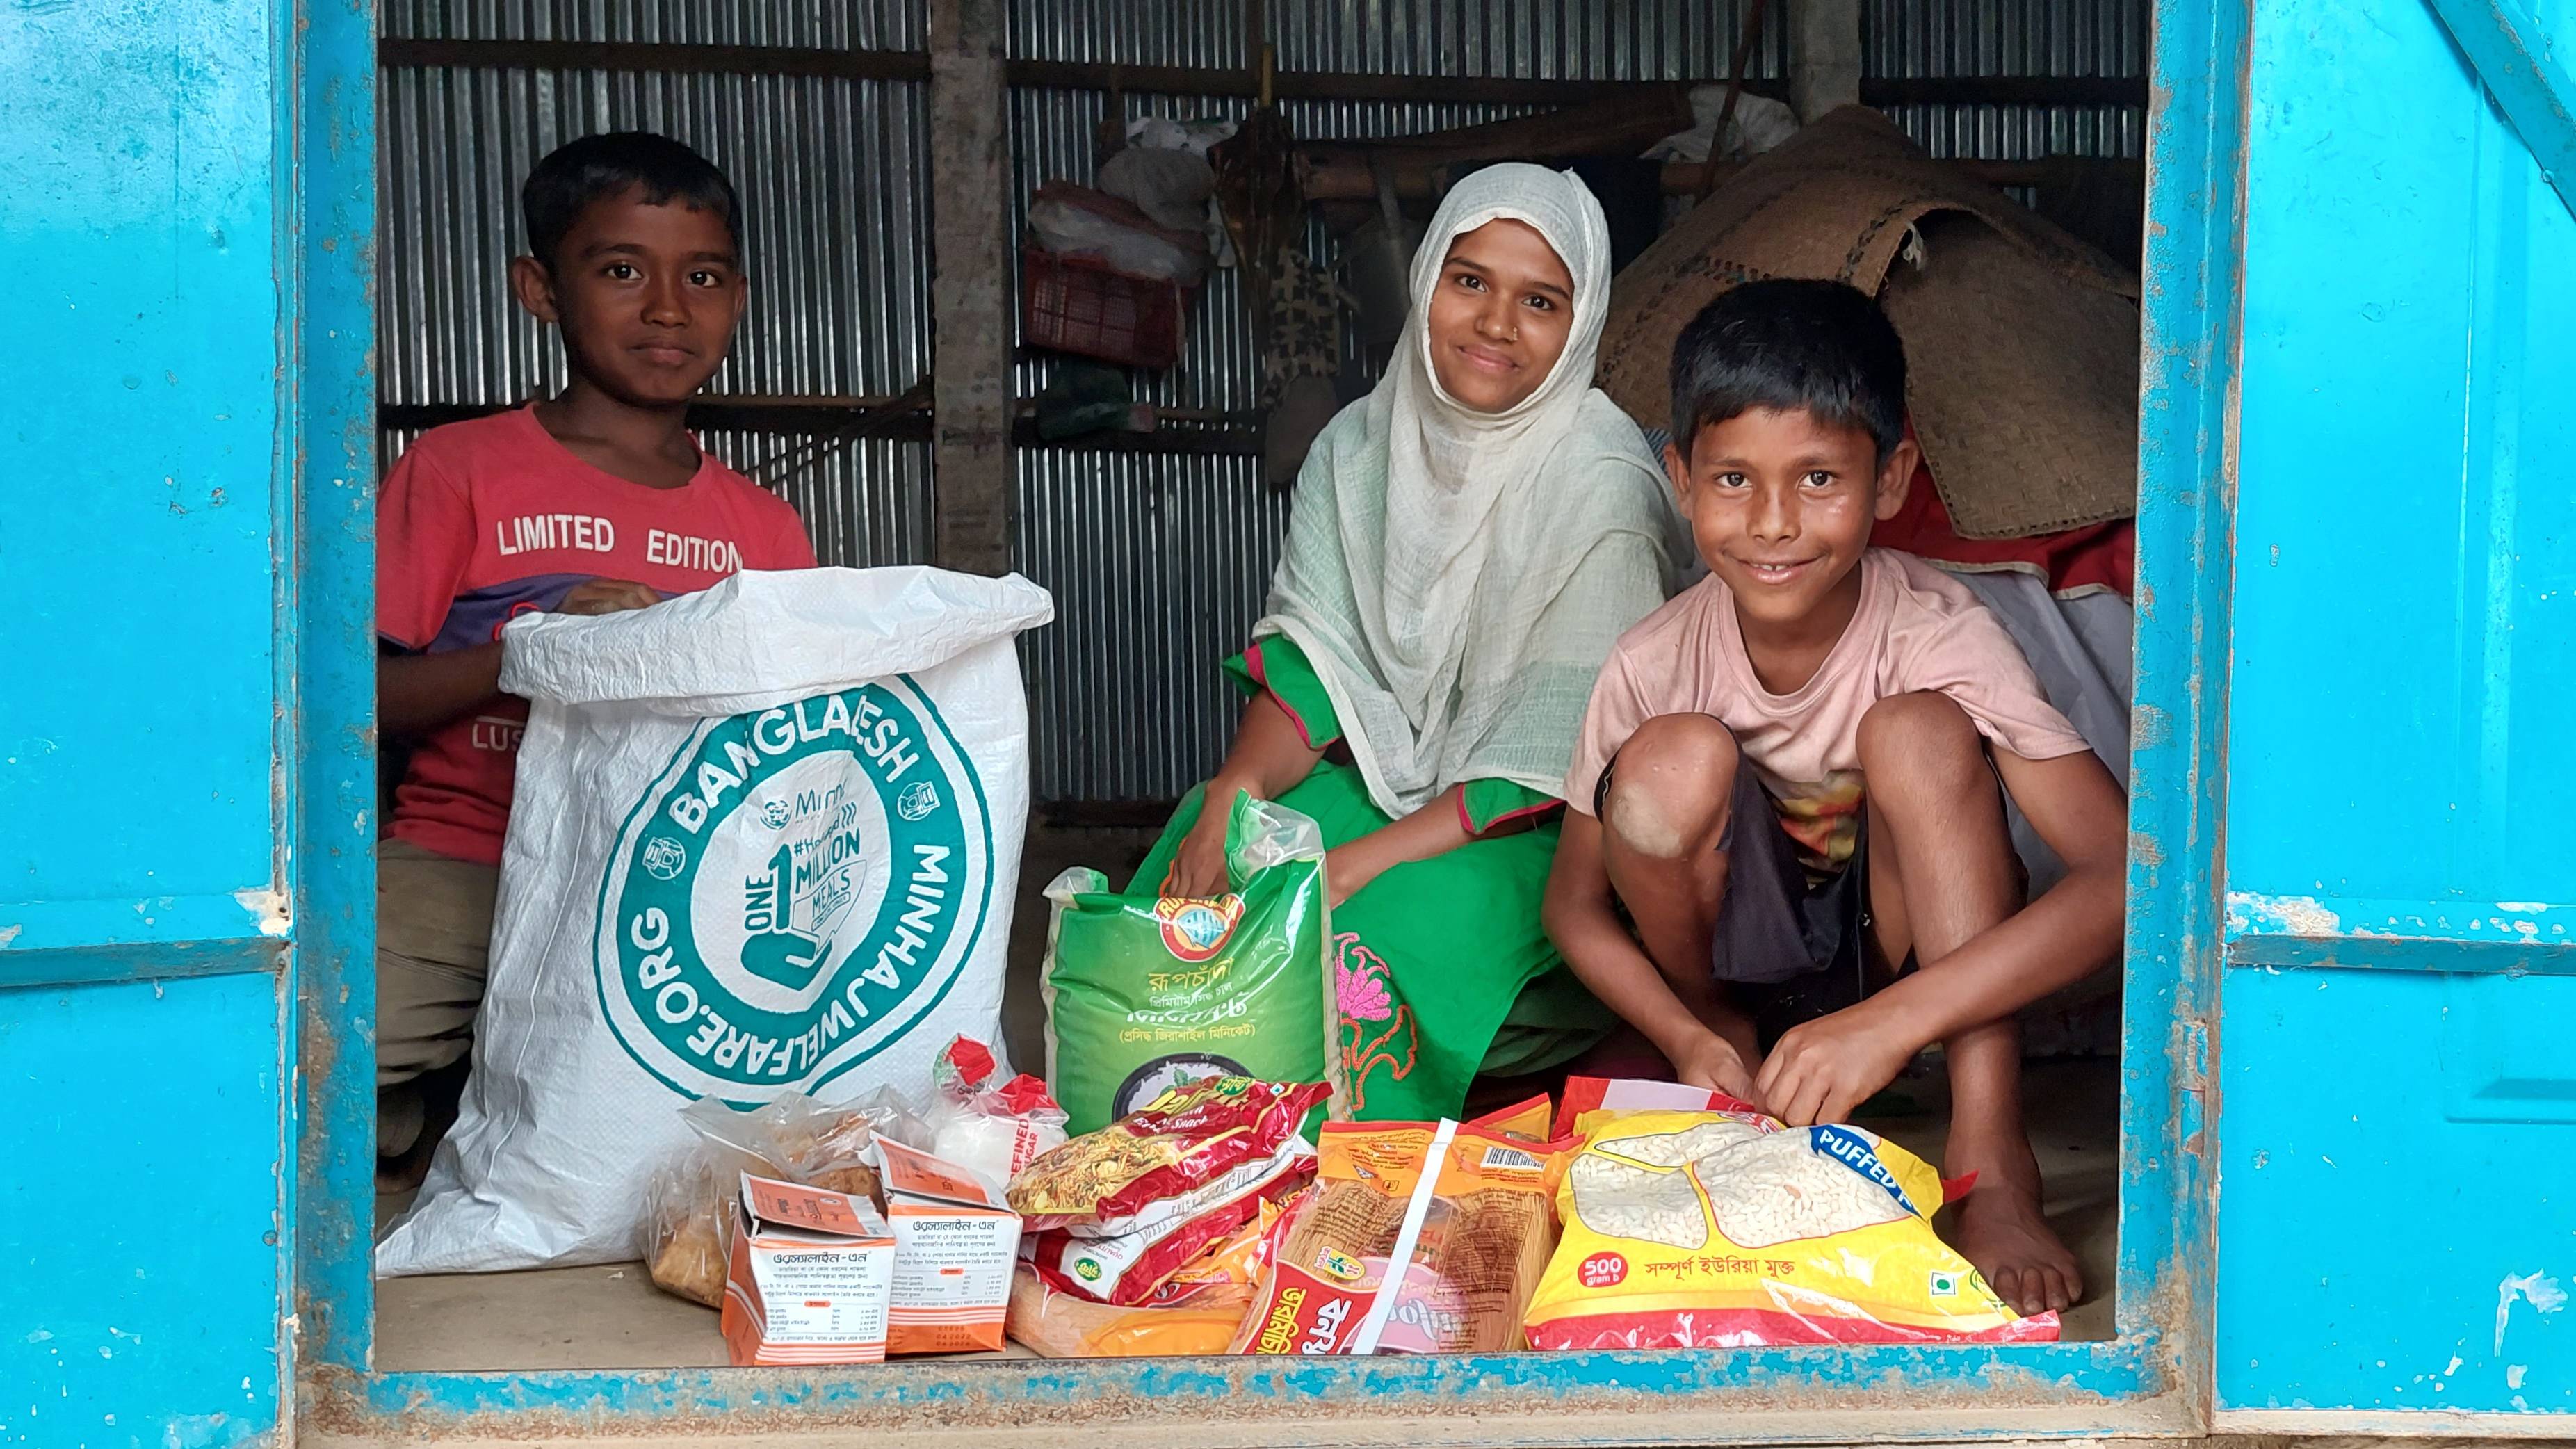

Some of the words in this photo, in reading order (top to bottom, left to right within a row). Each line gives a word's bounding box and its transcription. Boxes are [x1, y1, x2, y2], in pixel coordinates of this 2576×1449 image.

[496, 512, 615, 556] LIMITED
[647, 529, 743, 574] EDITION
[668, 694, 921, 834] BANGLAESH
[745, 873, 774, 931] ONE
[811, 868, 851, 918] MEALS
[1024, 1132, 1038, 1166] UGAR
[1819, 1128, 1897, 1188] PUFFED
[1584, 1257, 1622, 1277] 500
[1585, 1274, 1611, 1286] gram
[1644, 1255, 1694, 1281] সম্পূর্ণ
[1698, 1255, 1760, 1277] ইউরিয়া
[1764, 1258, 1796, 1280] মুক্ত
